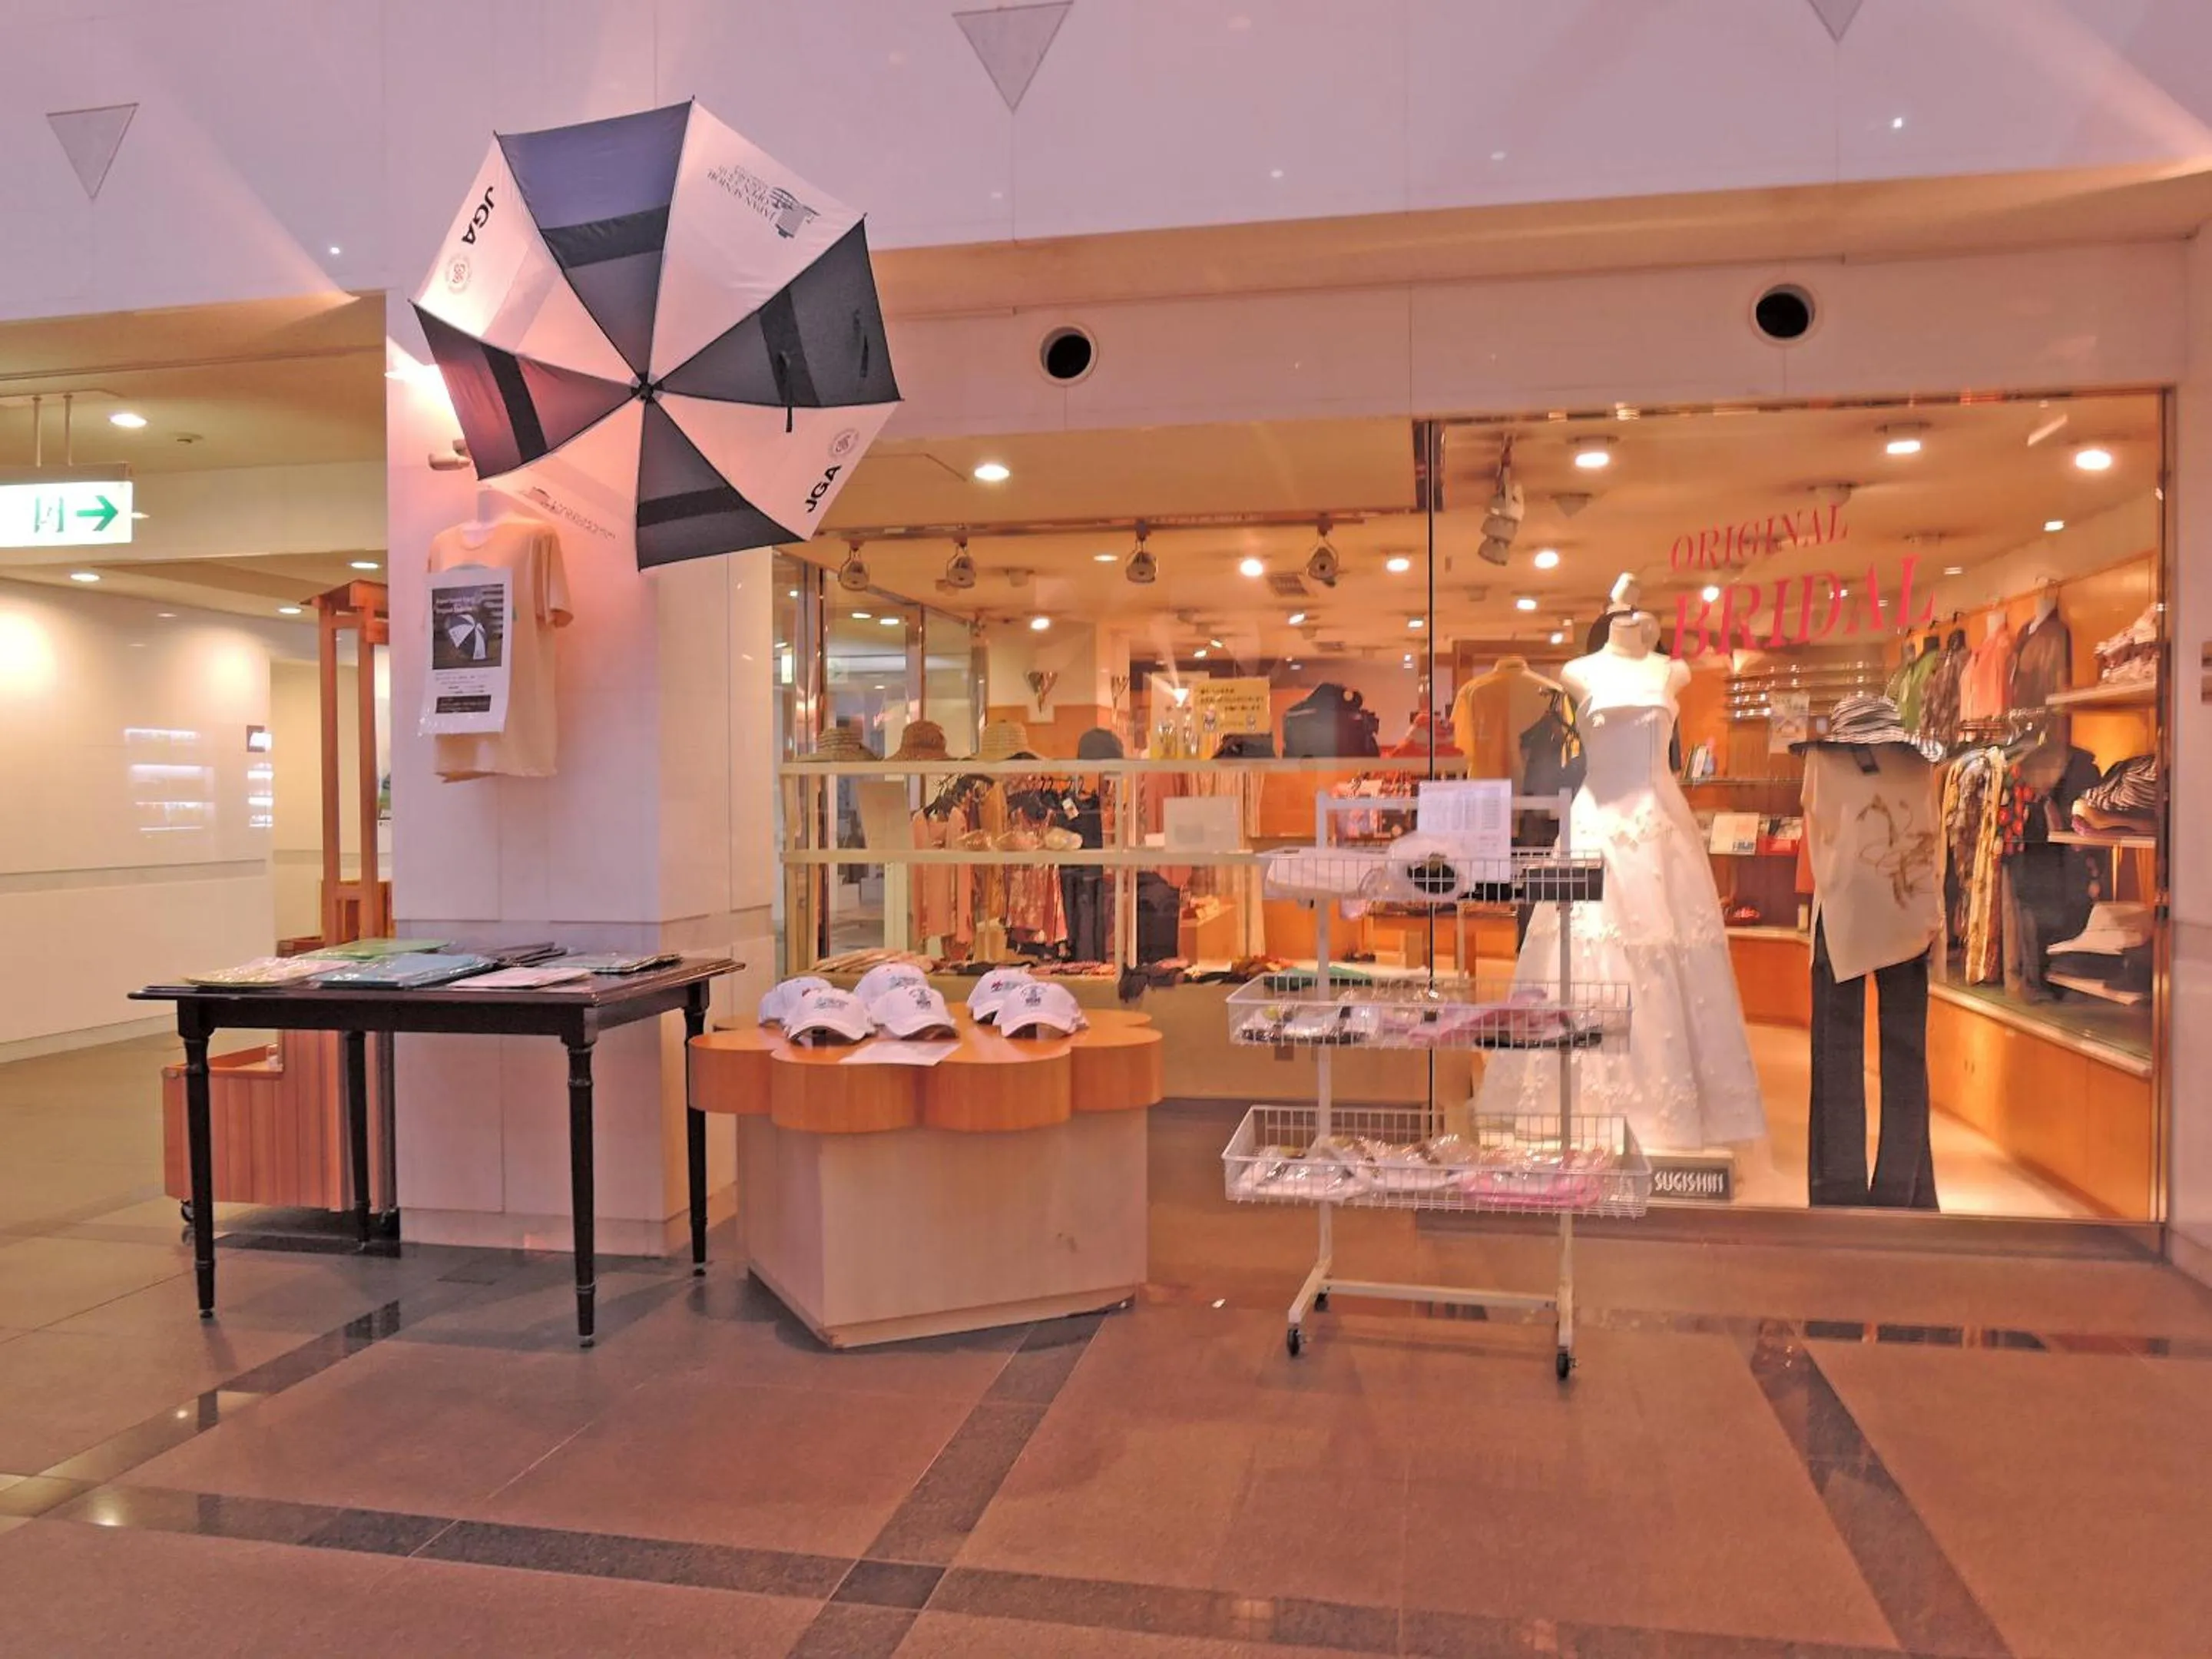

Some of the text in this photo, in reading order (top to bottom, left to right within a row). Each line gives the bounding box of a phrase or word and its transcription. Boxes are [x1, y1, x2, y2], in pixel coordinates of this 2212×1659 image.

[461, 186, 494, 245] JGA
[805, 465, 842, 513] JGA
[1671, 502, 1848, 571] ORIGINAL
[1669, 553, 1936, 661] BRIDAL
